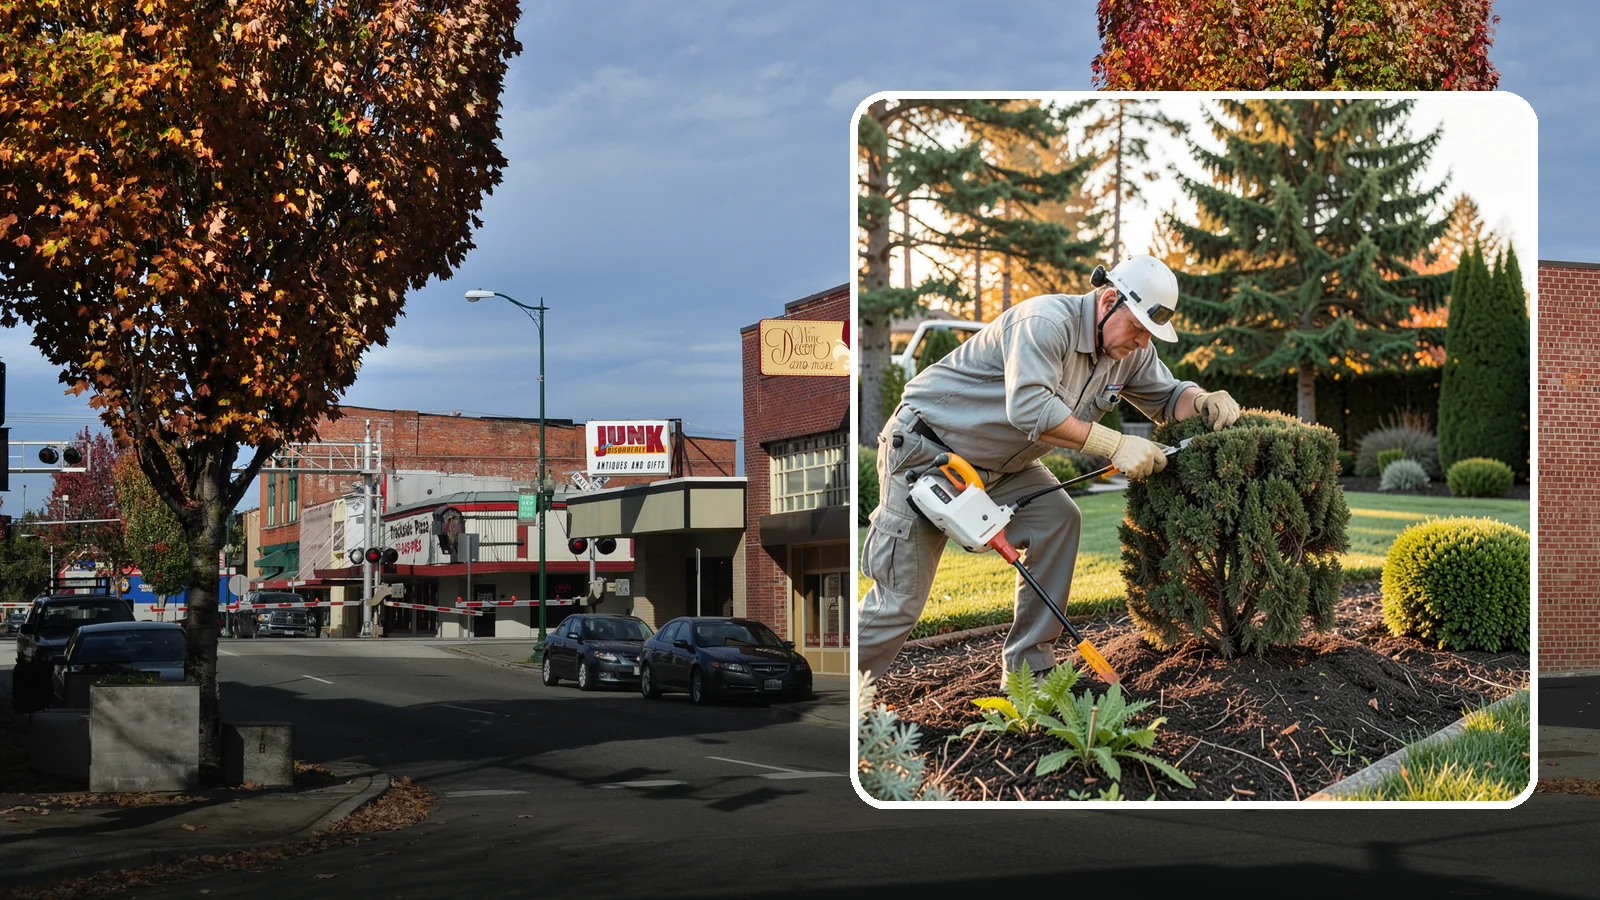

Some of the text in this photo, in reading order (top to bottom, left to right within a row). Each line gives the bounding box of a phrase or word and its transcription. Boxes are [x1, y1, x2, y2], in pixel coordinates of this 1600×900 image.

[595, 425, 665, 457] JUNK
[607, 446, 646, 454] DISORDERLY
[597, 460, 665, 470] ANTIQUES AND GIFTS
[414, 519, 429, 535] Pizza
